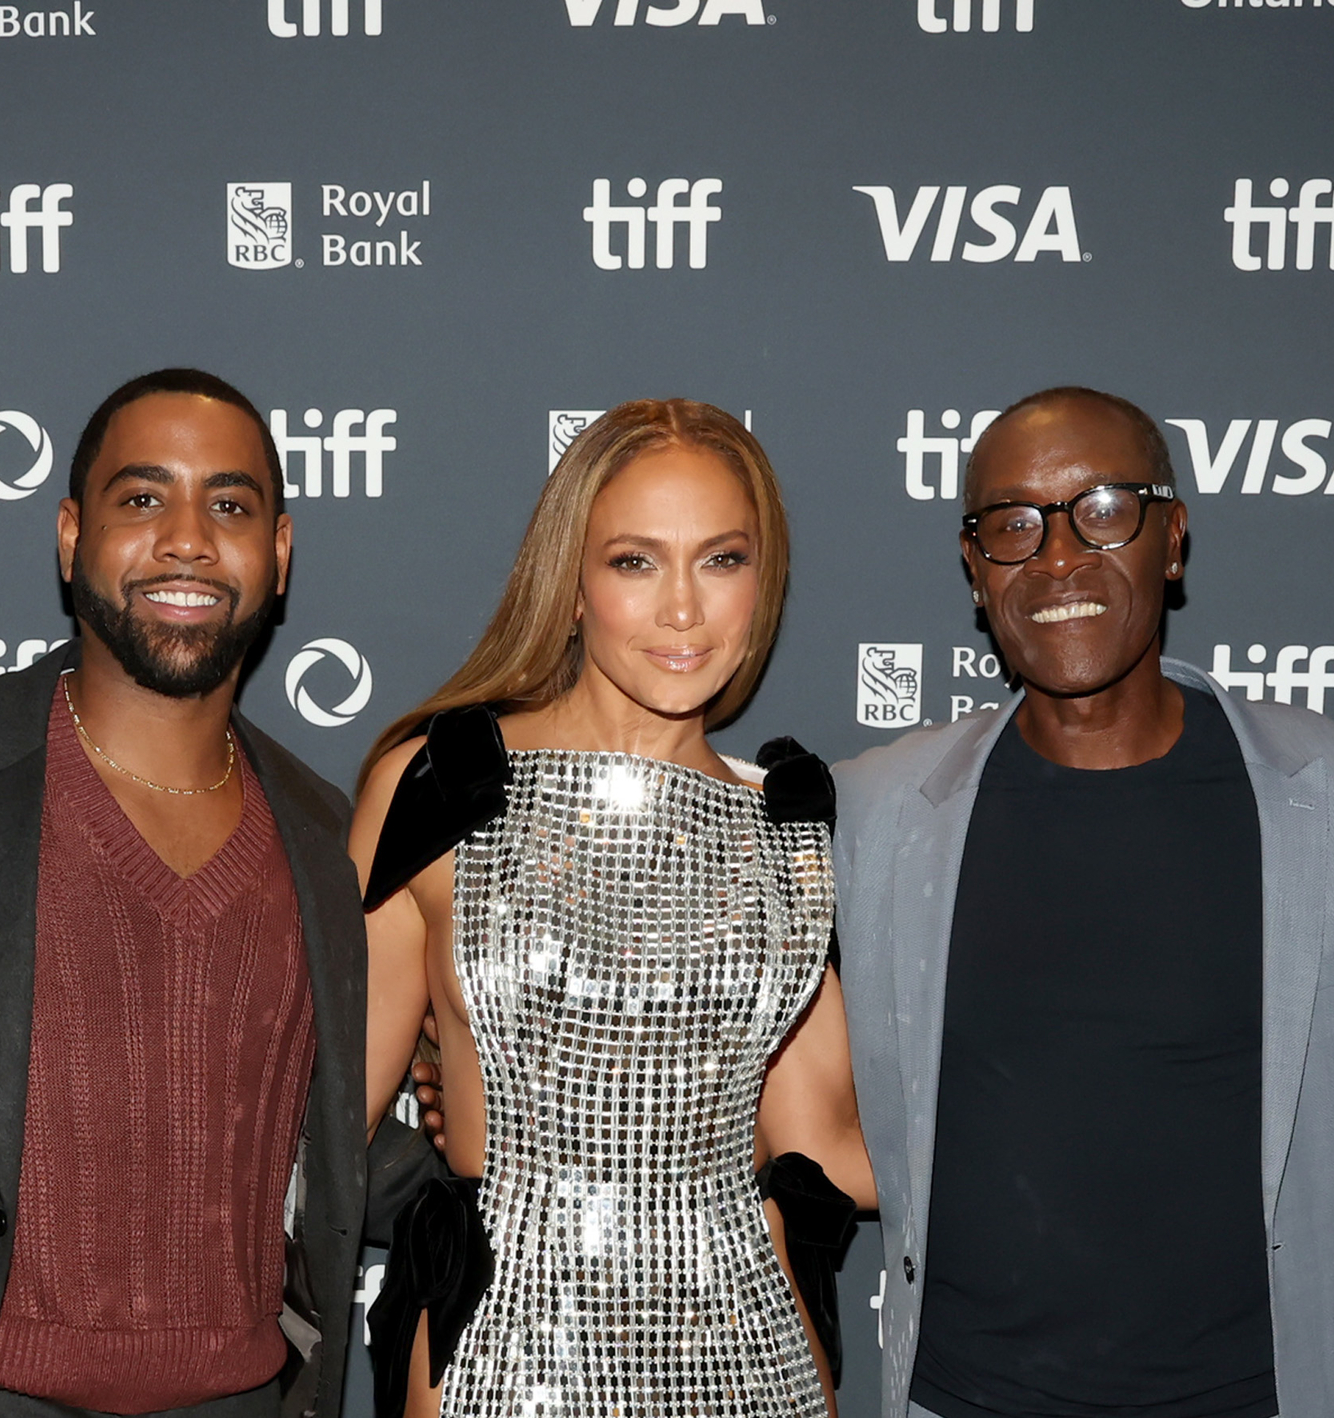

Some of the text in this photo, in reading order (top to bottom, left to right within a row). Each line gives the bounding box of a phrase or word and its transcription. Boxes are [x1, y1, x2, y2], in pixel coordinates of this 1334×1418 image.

[321, 180, 430, 227] Royal
[583, 177, 723, 270] tiff
[852, 184, 1082, 263] VISA
[235, 244, 285, 262] RBC
[322, 230, 423, 267] Bank
[896, 408, 1002, 501] ti
[864, 703, 914, 722] RBC
